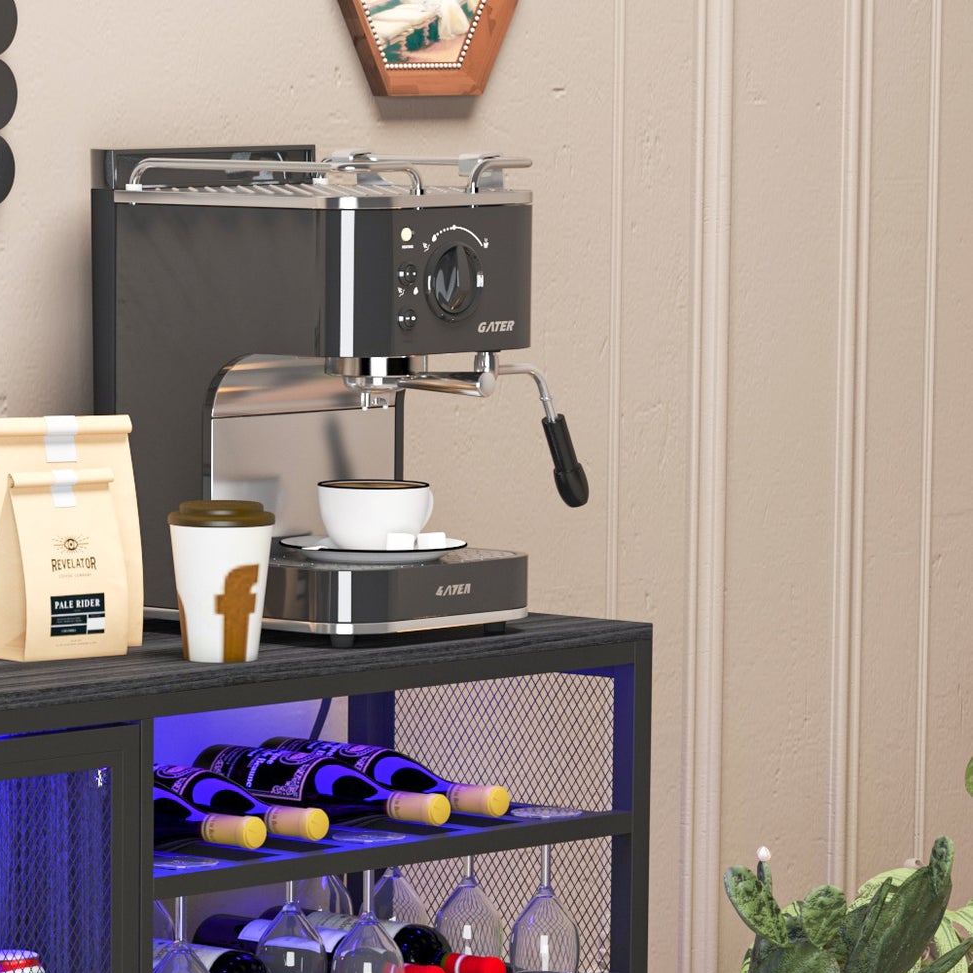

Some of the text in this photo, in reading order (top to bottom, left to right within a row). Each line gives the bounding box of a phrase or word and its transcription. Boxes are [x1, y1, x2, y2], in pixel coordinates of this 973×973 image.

[477, 320, 515, 334] GATER
[50, 556, 97, 572] REVELATOR
[54, 598, 101, 609] PALE RIDER
